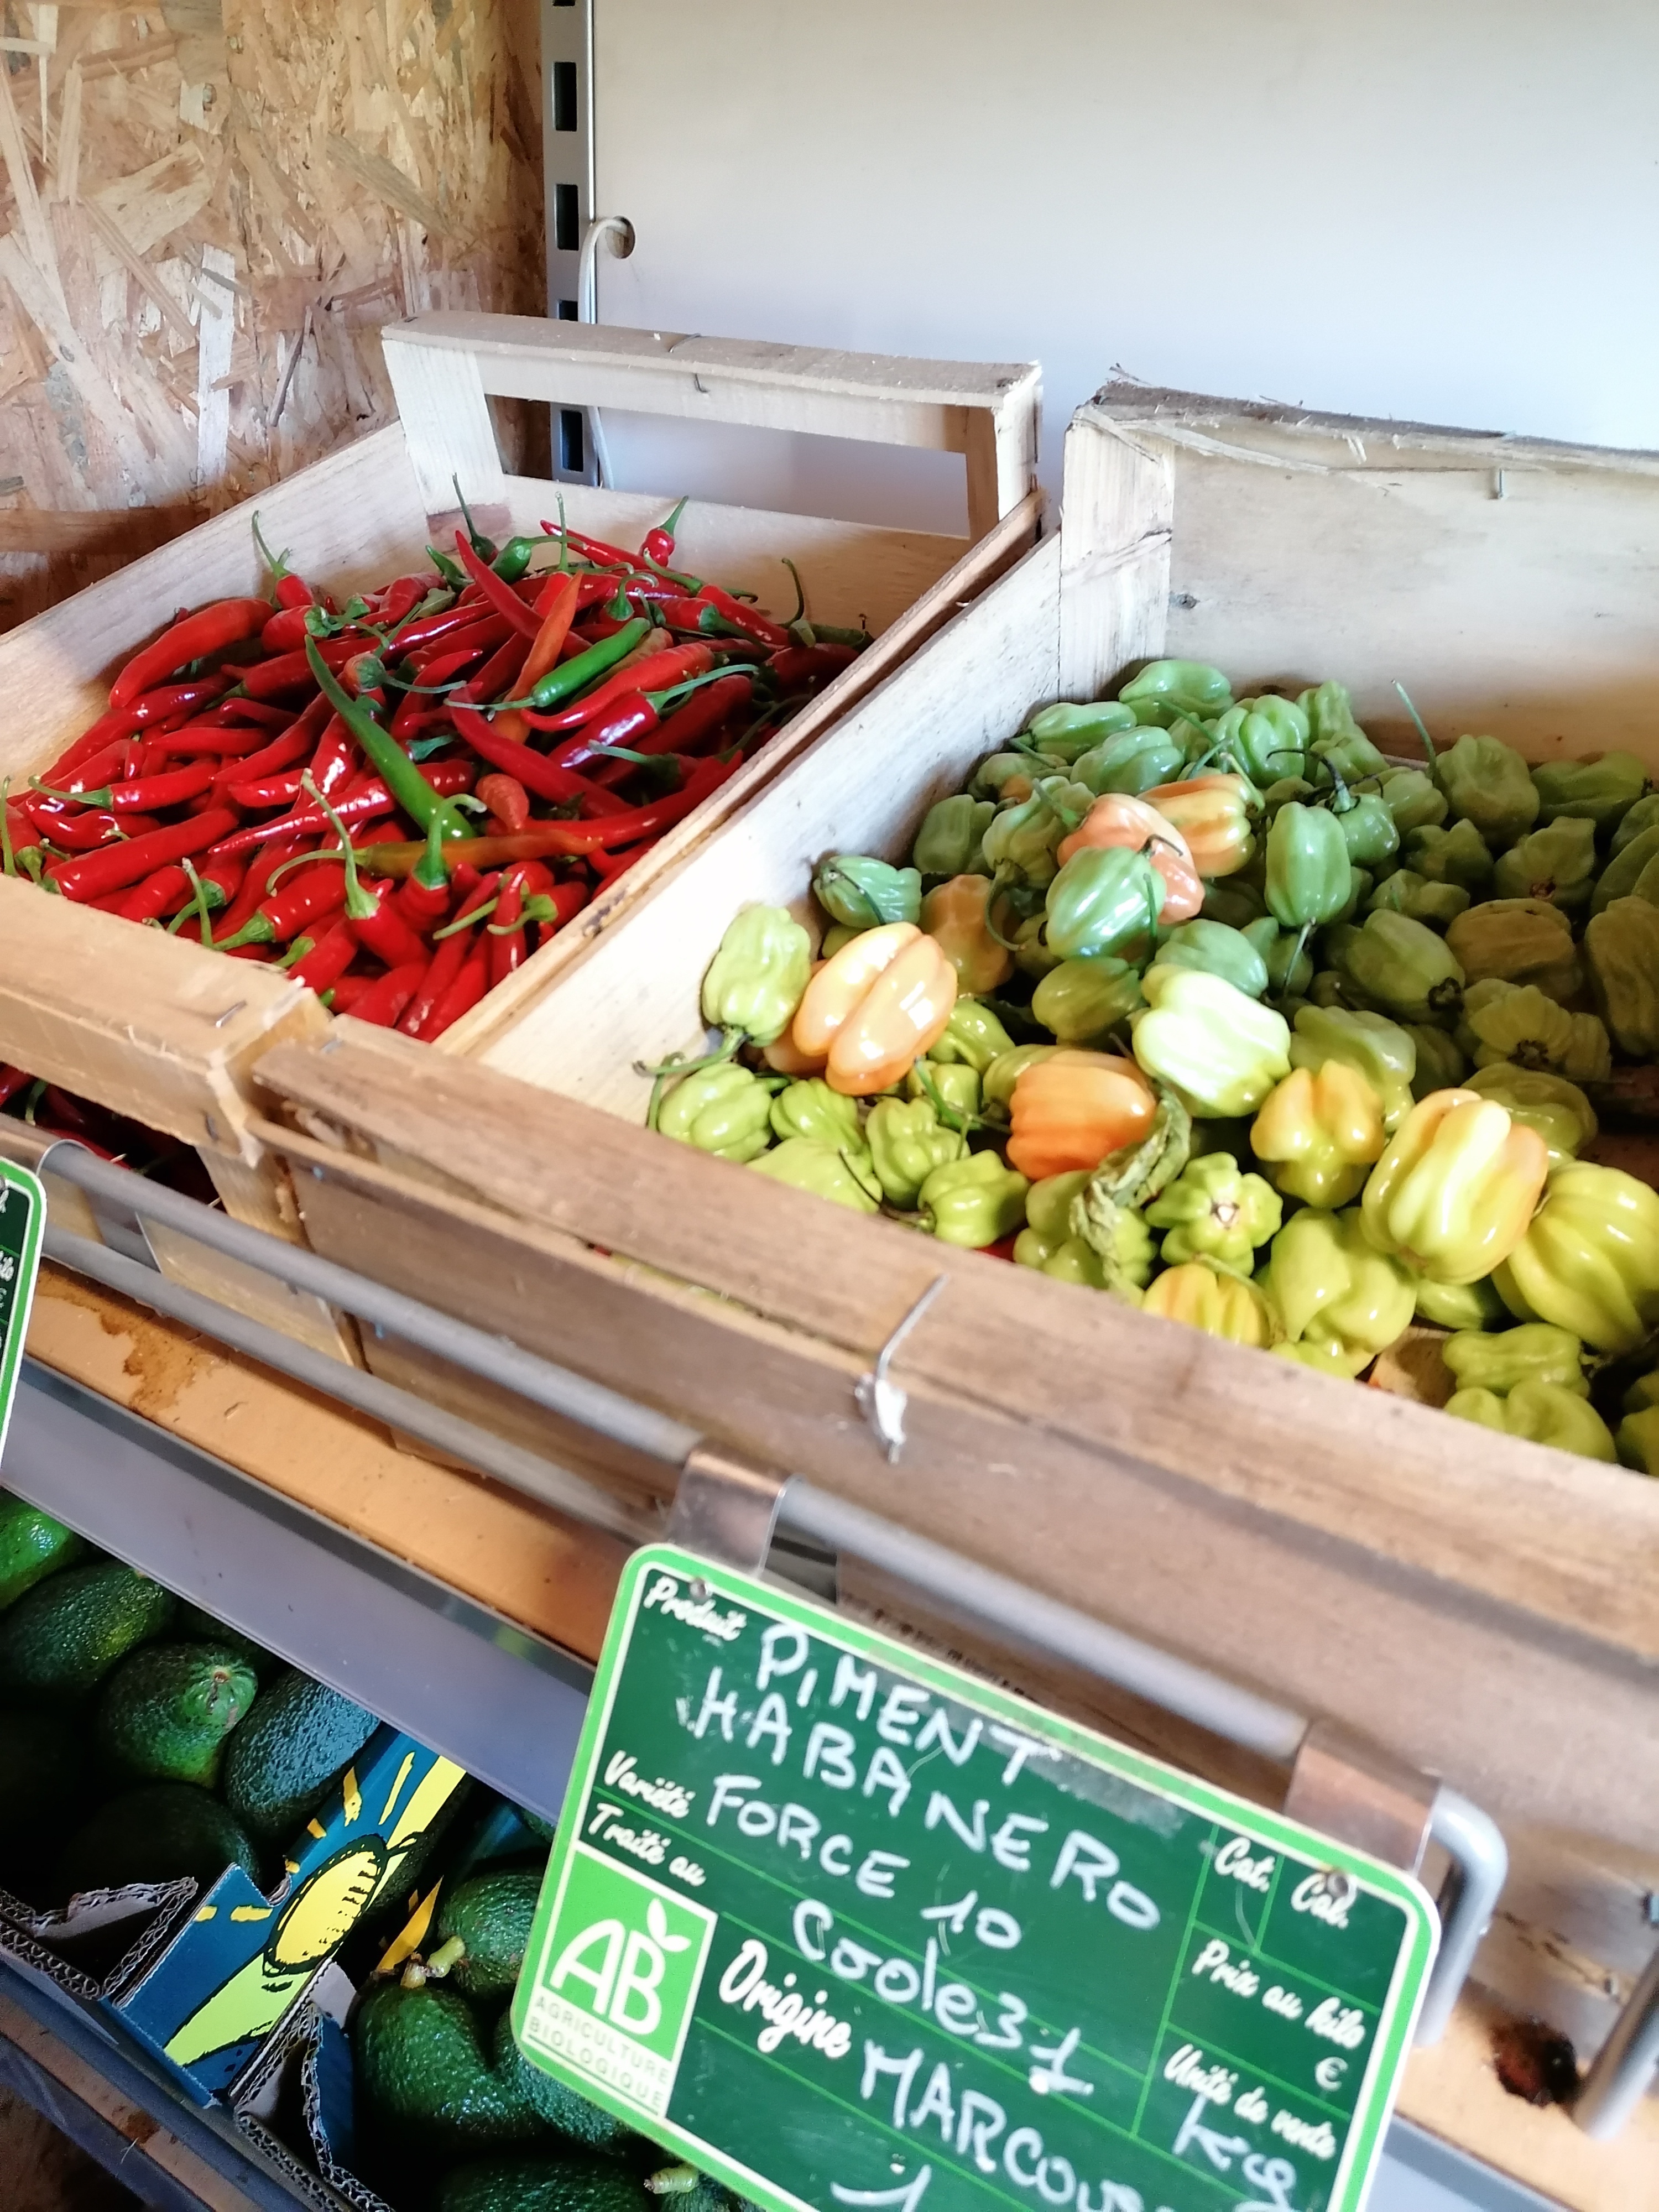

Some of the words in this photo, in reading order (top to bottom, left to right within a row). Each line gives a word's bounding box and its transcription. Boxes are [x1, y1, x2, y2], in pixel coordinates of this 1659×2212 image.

[643, 1575, 747, 1641] Produit
[756, 1623, 1063, 1785] PIMENT
[603, 1750, 696, 1818] Variété
[693, 1666, 1160, 1929] HABANERO
[588, 1802, 671, 1865] Traité
[669, 1856, 707, 1886] au
[706, 1773, 911, 1898] FORCE
[920, 1890, 1022, 1950] 10
[549, 1918, 666, 2036] AB
[719, 1939, 852, 2059] Origine
[1191, 1938, 1260, 1999] Prix
[1261, 1985, 1304, 2020] au
[1304, 1996, 1366, 2049] kilo
[528, 2016, 664, 2109] BIOLOGIQUE
[533, 1995, 670, 2085] AGRICULTURE
[1313, 2056, 1349, 2091] €
[1164, 2044, 1239, 2105] Unité
[1234, 2085, 1269, 2124] de
[1270, 2109, 1337, 2161] vente
